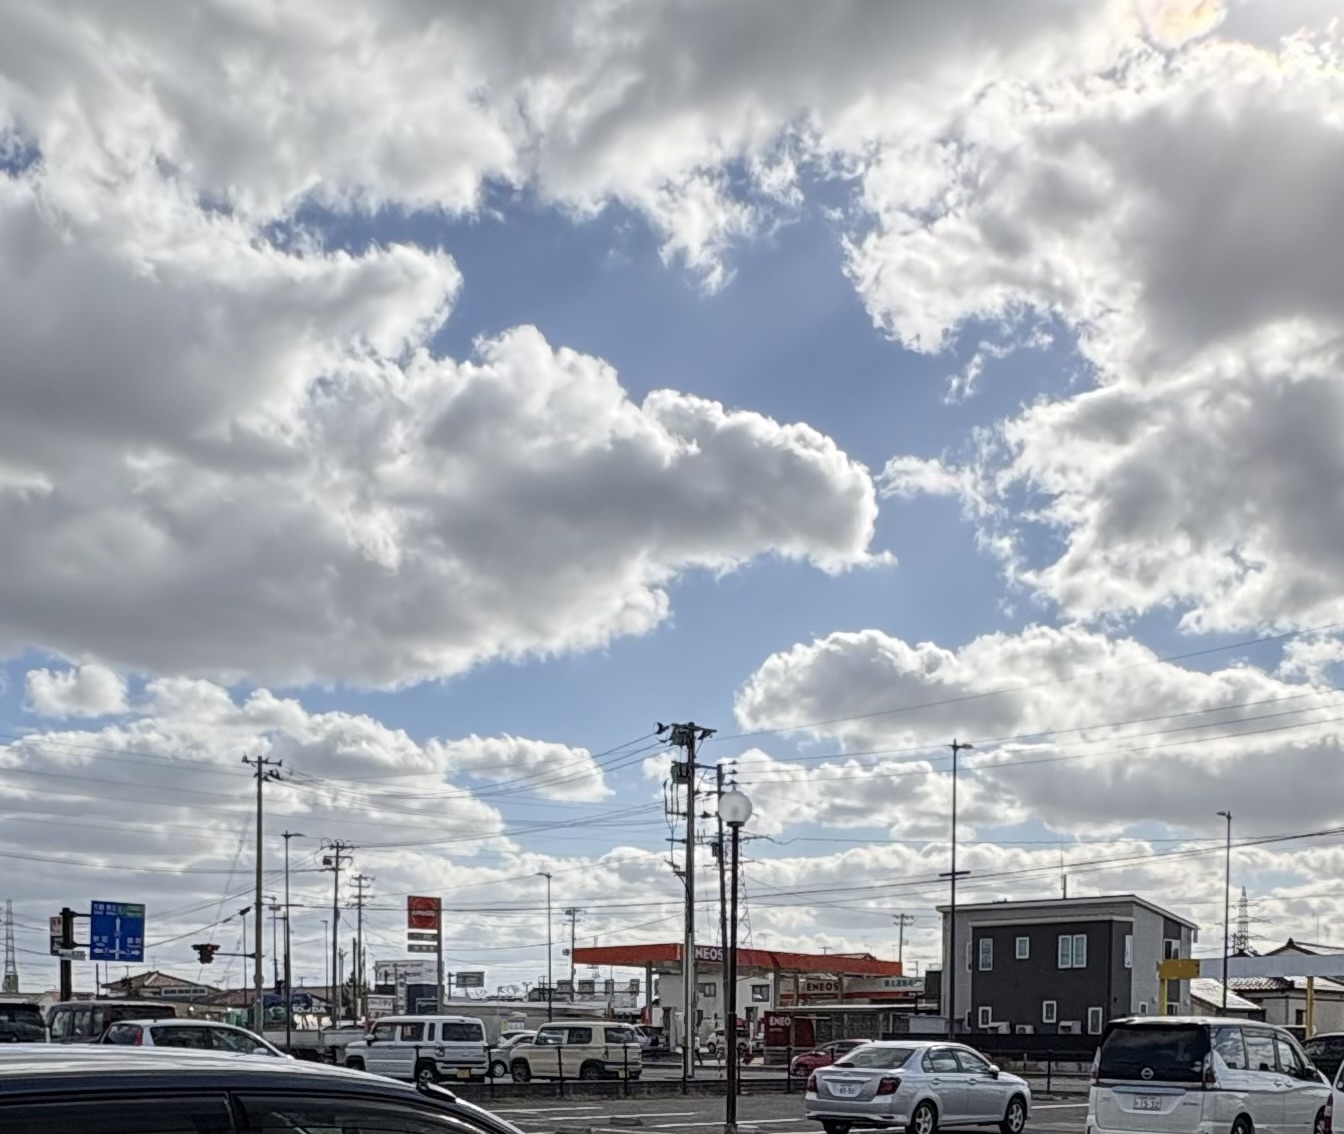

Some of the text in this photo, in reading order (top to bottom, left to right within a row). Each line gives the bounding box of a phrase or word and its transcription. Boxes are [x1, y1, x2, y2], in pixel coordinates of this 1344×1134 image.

[694, 947, 724, 961] NEOS
[806, 981, 841, 992] ENEOS
[769, 1016, 792, 1027] ENEO
